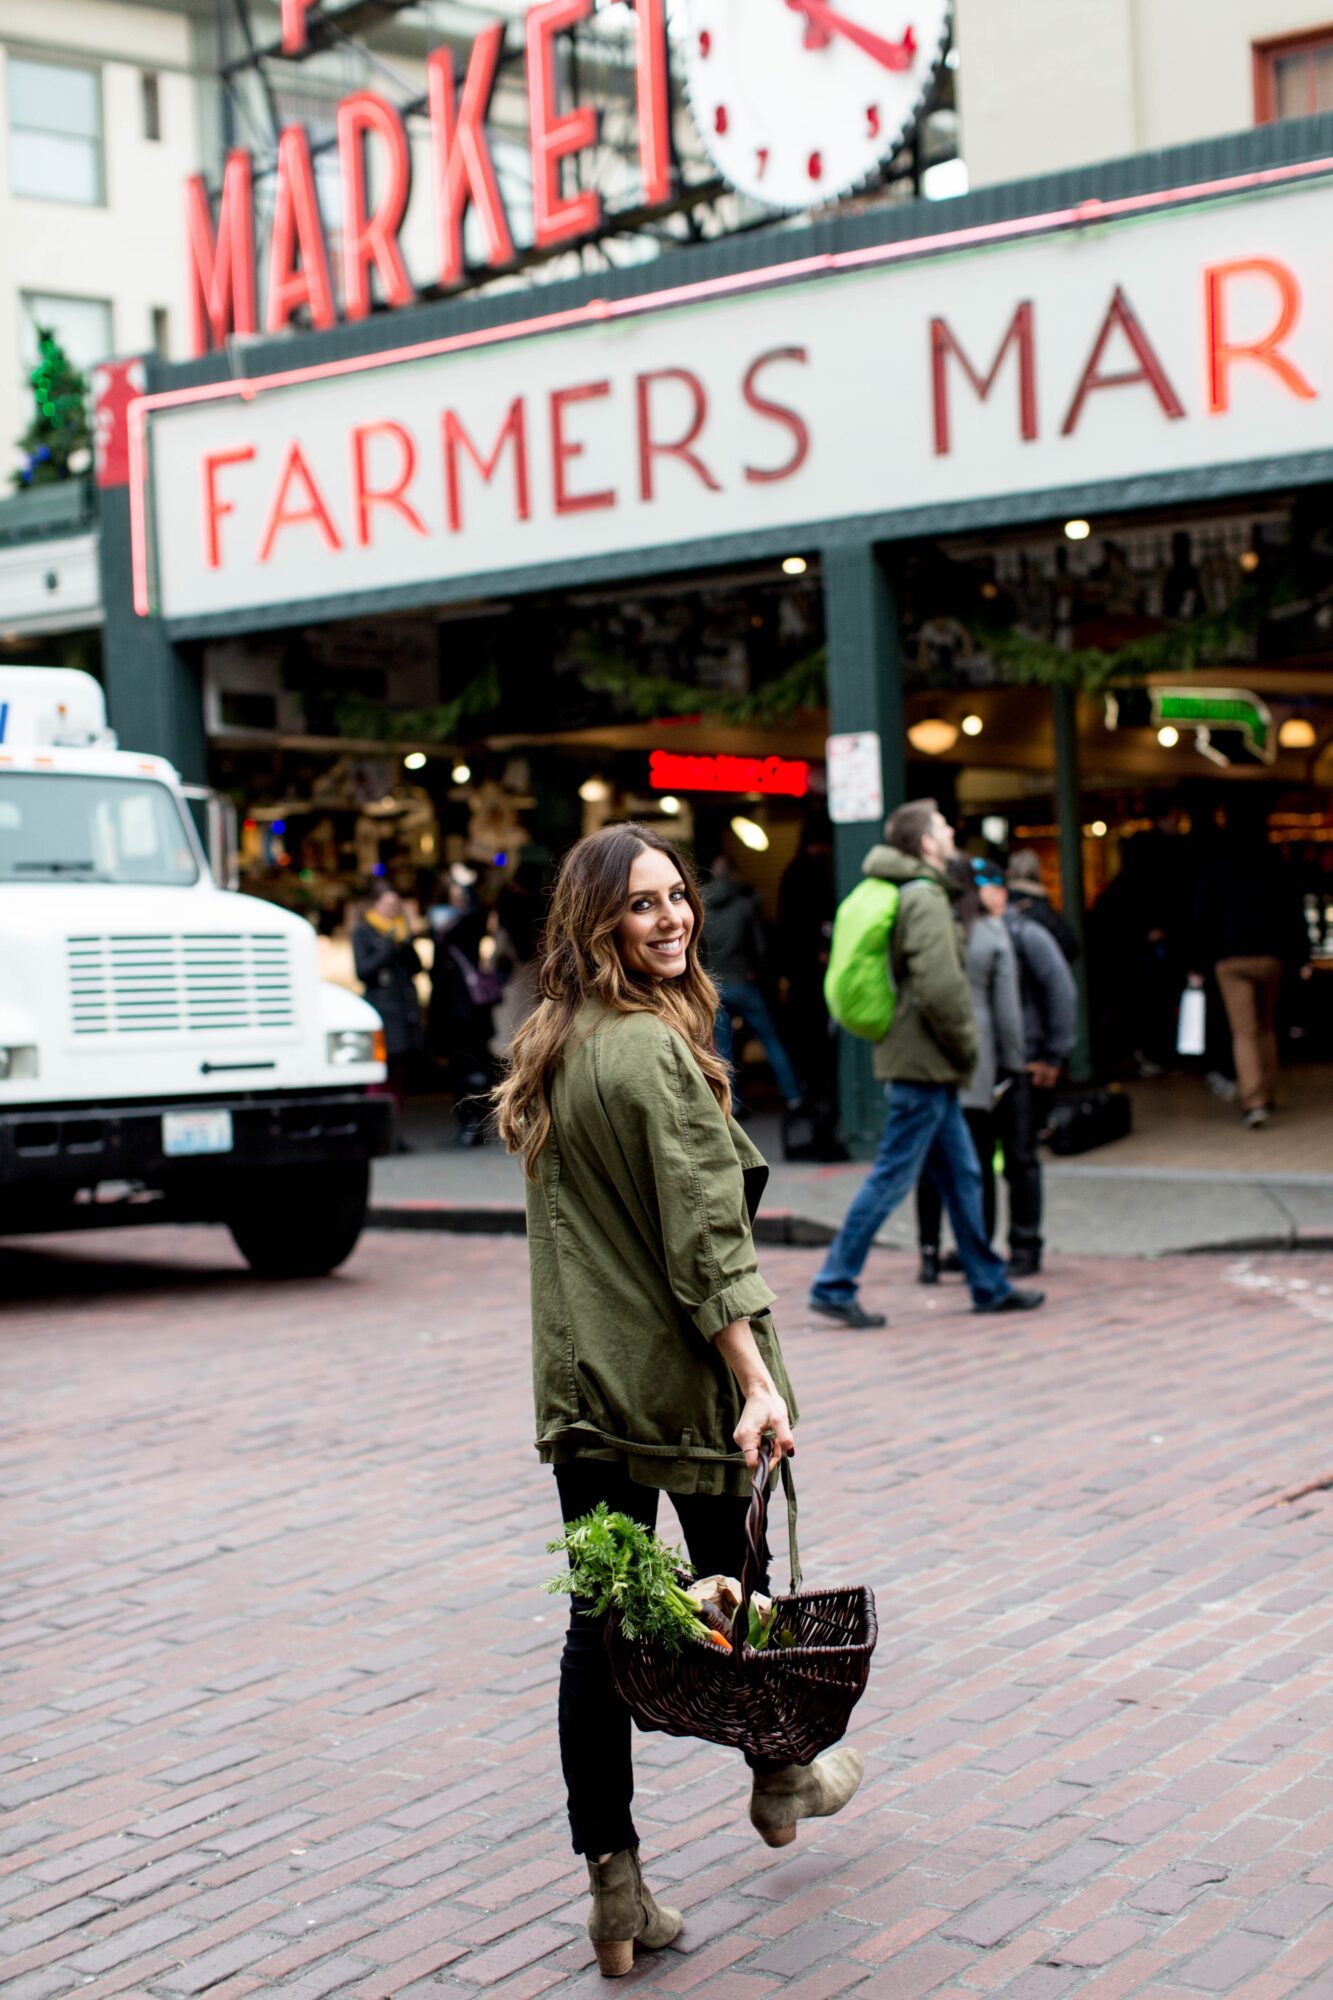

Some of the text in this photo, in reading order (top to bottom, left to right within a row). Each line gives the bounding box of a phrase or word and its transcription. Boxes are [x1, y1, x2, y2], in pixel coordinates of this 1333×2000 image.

[756, 149, 768, 181] 7
[203, 254, 1318, 569] FARMERS MAR
